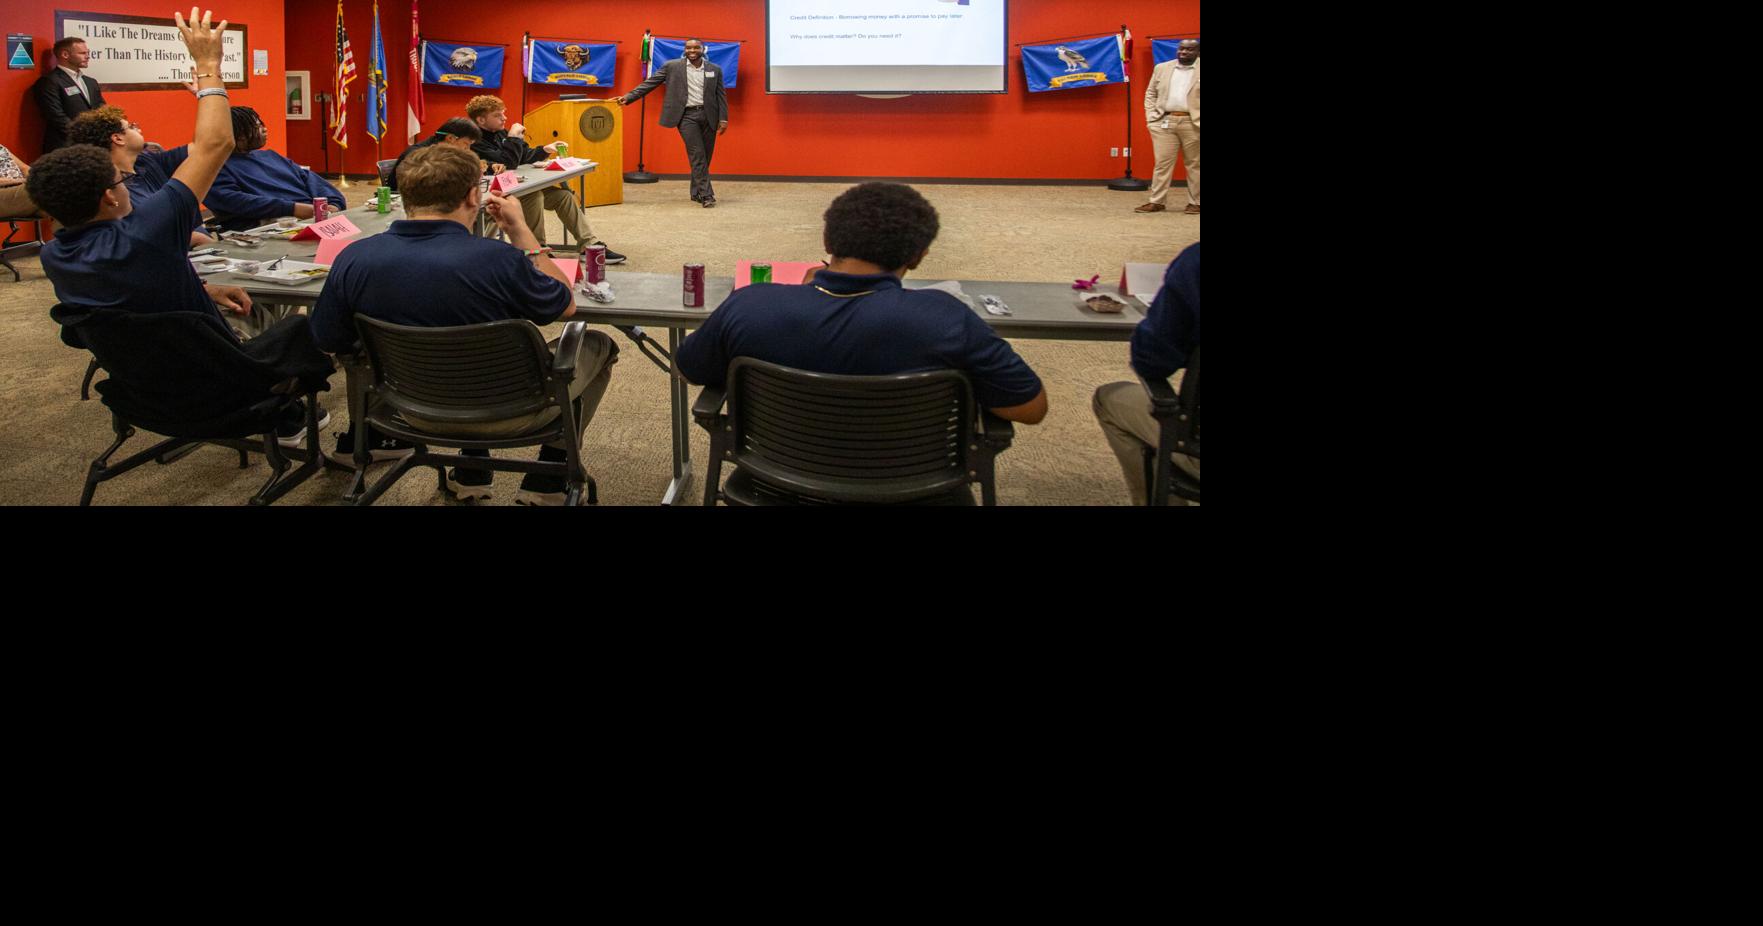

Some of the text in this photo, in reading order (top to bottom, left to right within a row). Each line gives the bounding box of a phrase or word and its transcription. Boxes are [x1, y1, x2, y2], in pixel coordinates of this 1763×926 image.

[94, 25, 117, 39] Like
[119, 26, 138, 39] The
[141, 28, 175, 41] Dreams
[105, 47, 131, 60] Than
[133, 48, 152, 60] The
[154, 49, 186, 63] History
